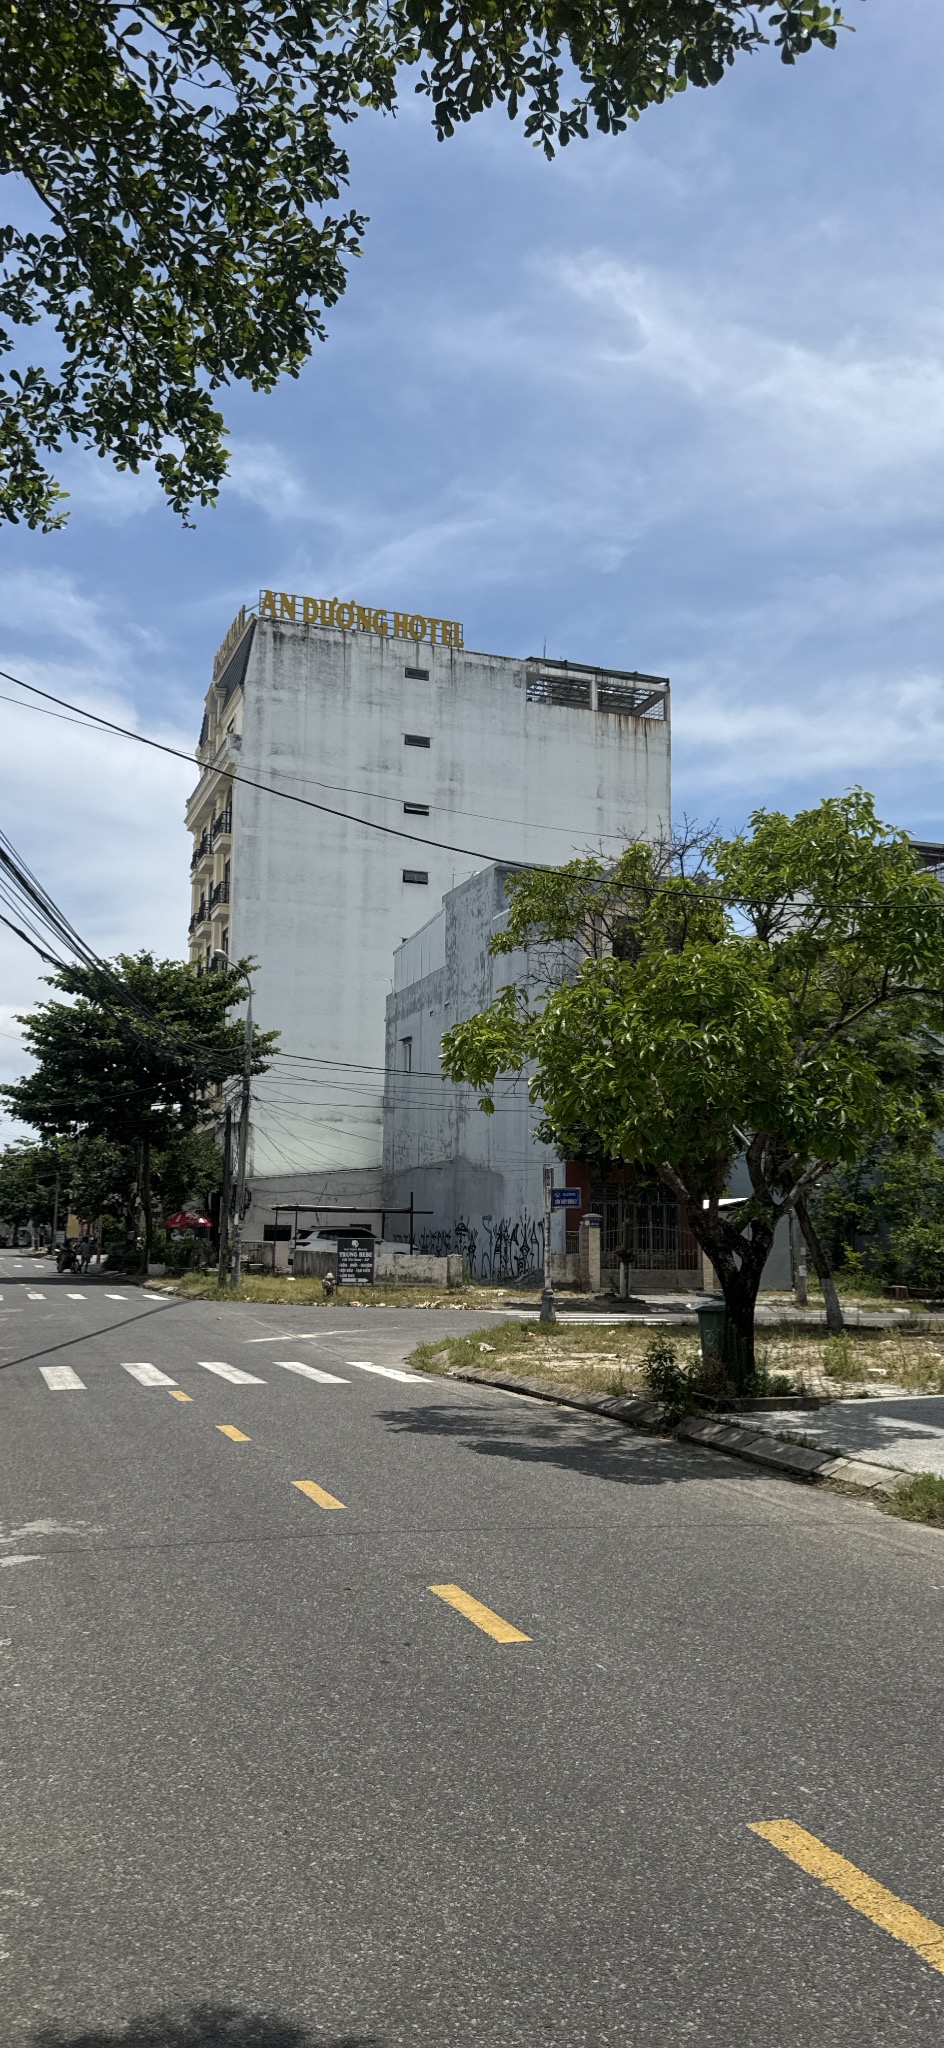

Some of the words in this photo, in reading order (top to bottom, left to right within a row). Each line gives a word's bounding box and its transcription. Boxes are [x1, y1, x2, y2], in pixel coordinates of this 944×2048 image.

[261, 589, 297, 620] AN
[303, 596, 389, 637] DƯƠNG
[393, 611, 465, 648] HOTEL
